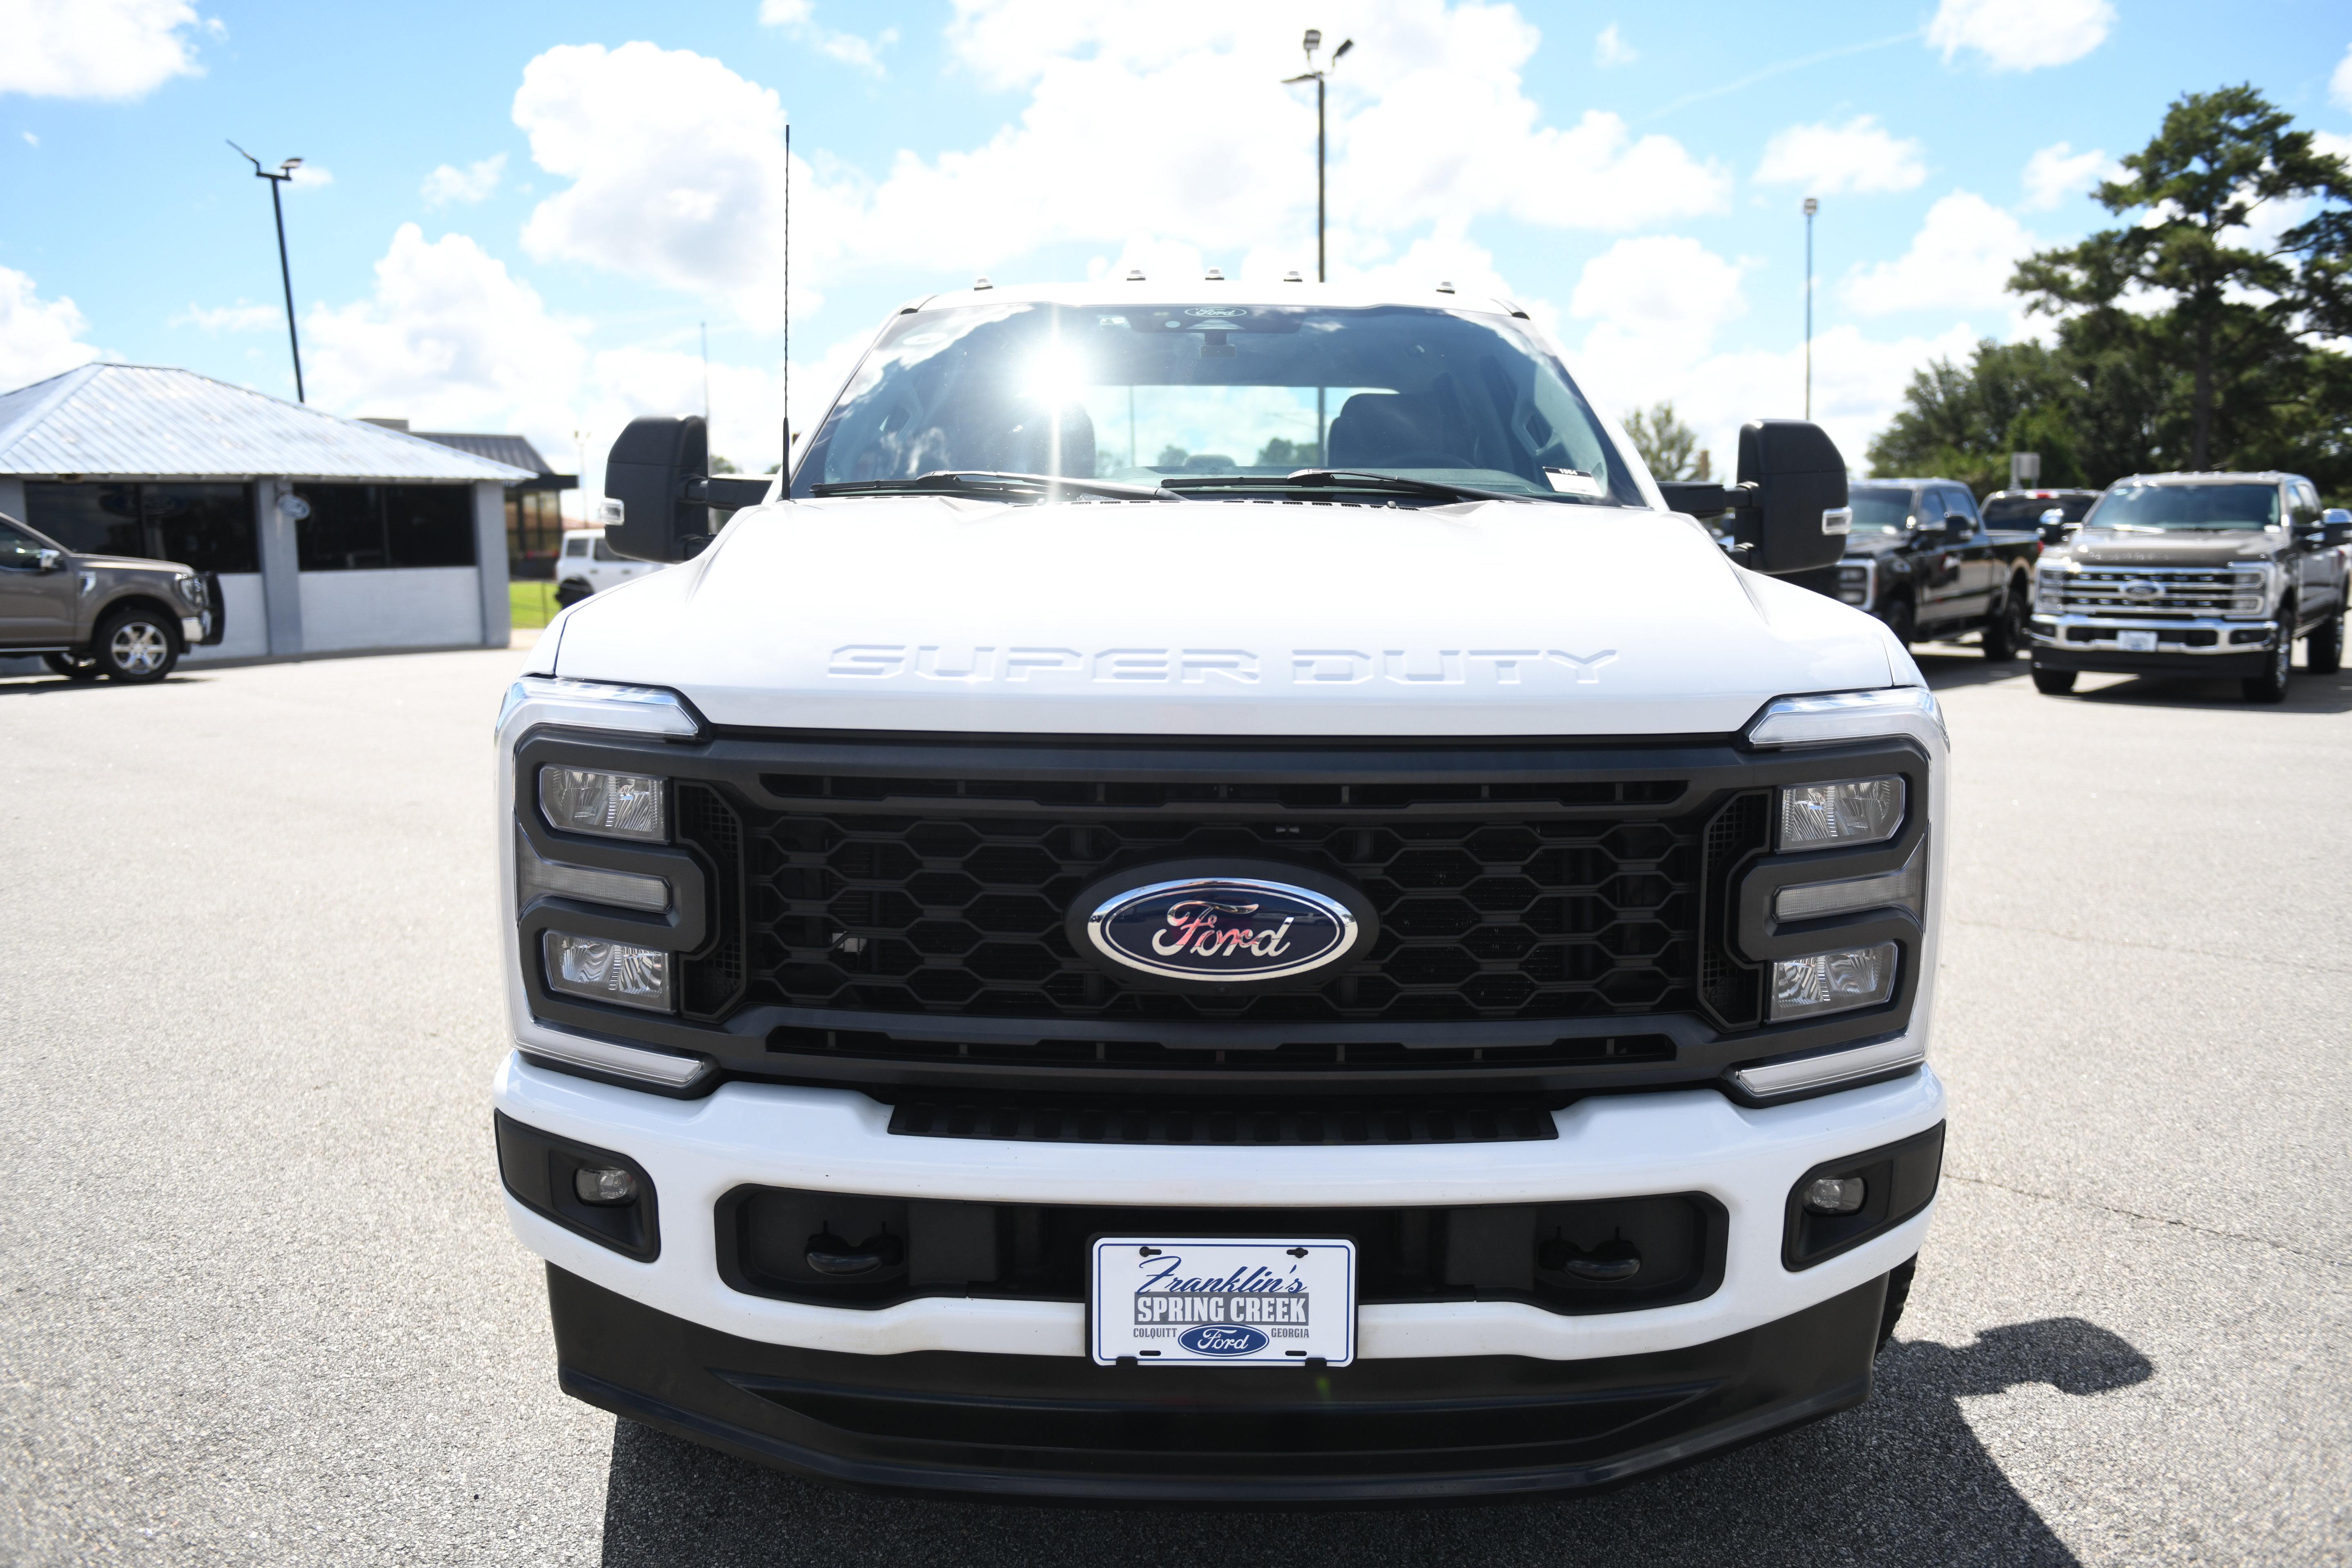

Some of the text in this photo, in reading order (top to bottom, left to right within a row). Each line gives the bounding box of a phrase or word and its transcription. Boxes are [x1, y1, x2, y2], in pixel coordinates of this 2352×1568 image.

[827, 644, 1620, 684] SUPER DUTY
[1151, 900, 1294, 957] Ford
[1136, 1256, 1307, 1295] Franklin's
[1137, 1296, 1306, 1322] SPRING CREEK
[1133, 1328, 1177, 1339] COLQUITT
[1197, 1328, 1249, 1349] Ford
[1271, 1328, 1310, 1338] GEORGIA
